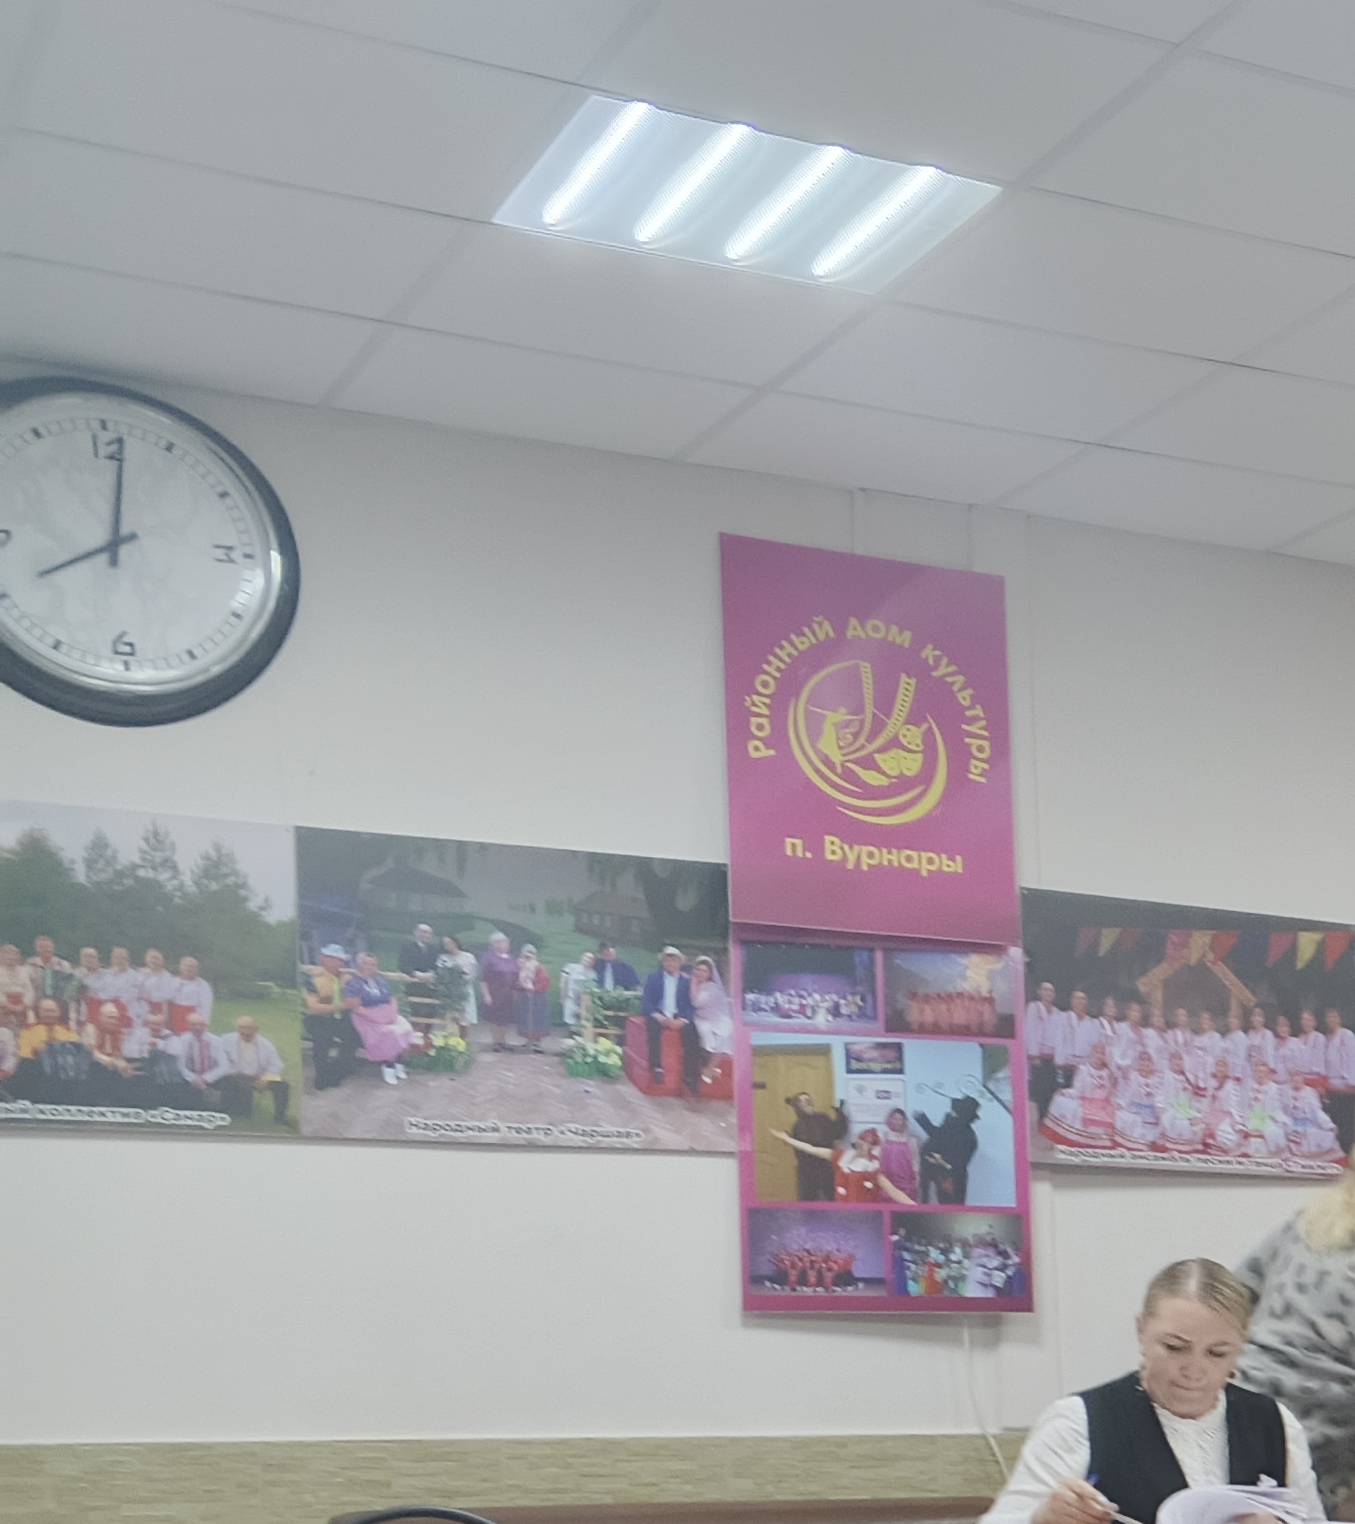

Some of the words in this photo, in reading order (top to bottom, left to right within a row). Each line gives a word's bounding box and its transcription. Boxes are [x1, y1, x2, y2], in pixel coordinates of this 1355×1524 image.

[112, 630, 136, 656] 6
[784, 836, 813, 859] п.
[823, 834, 964, 877] Вурнары
